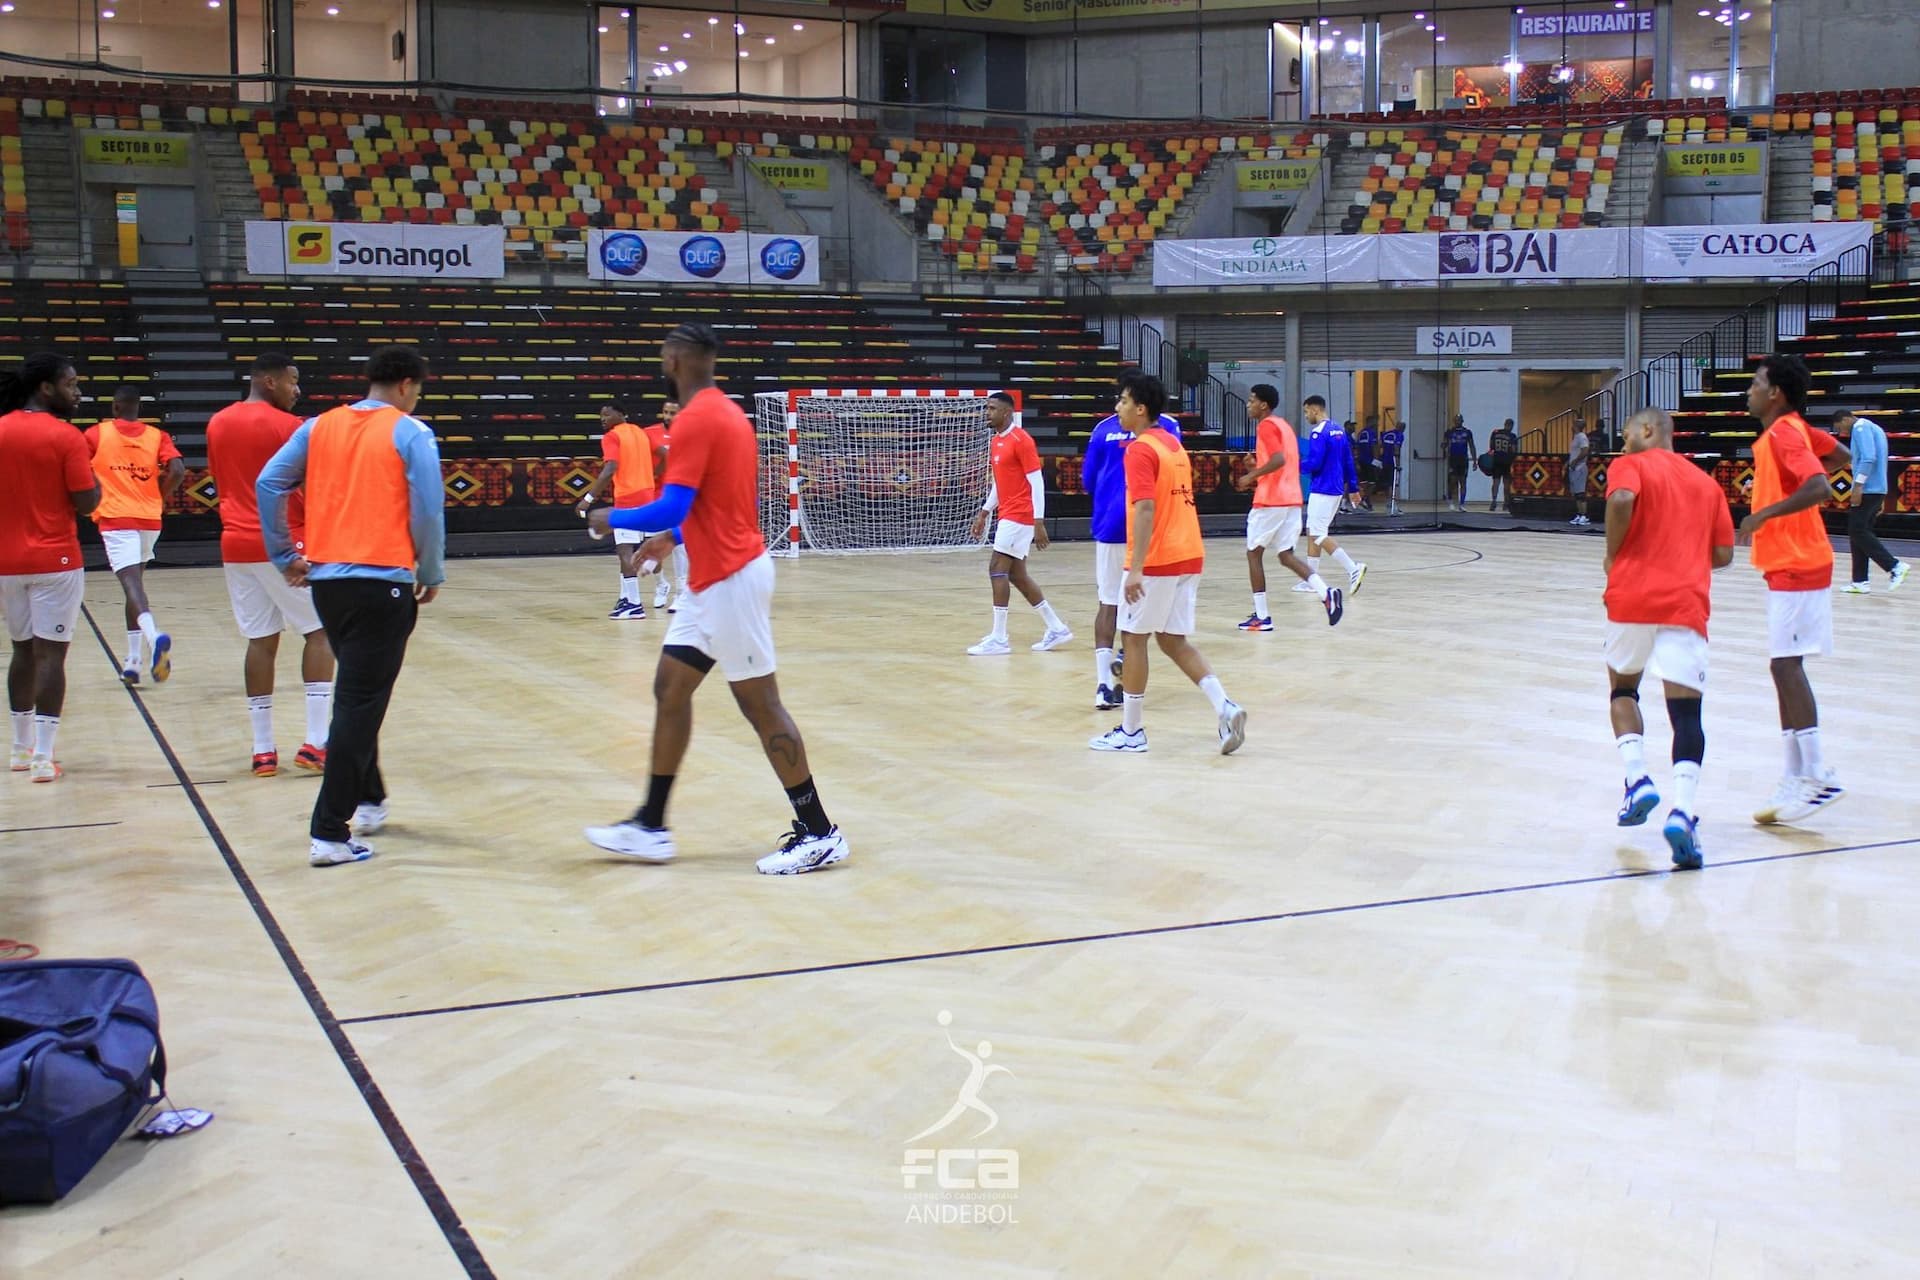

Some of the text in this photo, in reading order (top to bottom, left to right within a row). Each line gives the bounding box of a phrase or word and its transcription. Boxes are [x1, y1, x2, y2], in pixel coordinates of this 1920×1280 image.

[1023, 0, 1068, 12] Senior
[1521, 12, 1650, 35] RESTAURANTE
[101, 140, 171, 154] SECTOR 02
[1681, 152, 1745, 165] SECTOR 05
[761, 166, 815, 178] SECTOR 01
[1250, 168, 1307, 180] SECTOR 03
[1702, 233, 1817, 255] CATOCA
[338, 240, 472, 273] Sonangol
[605, 246, 642, 263] pura
[685, 249, 720, 265] pura
[766, 251, 800, 267] pura
[1485, 232, 1557, 274] BAI
[1221, 260, 1307, 273] ENDIAMA
[1432, 328, 1496, 348] SAÍDA
